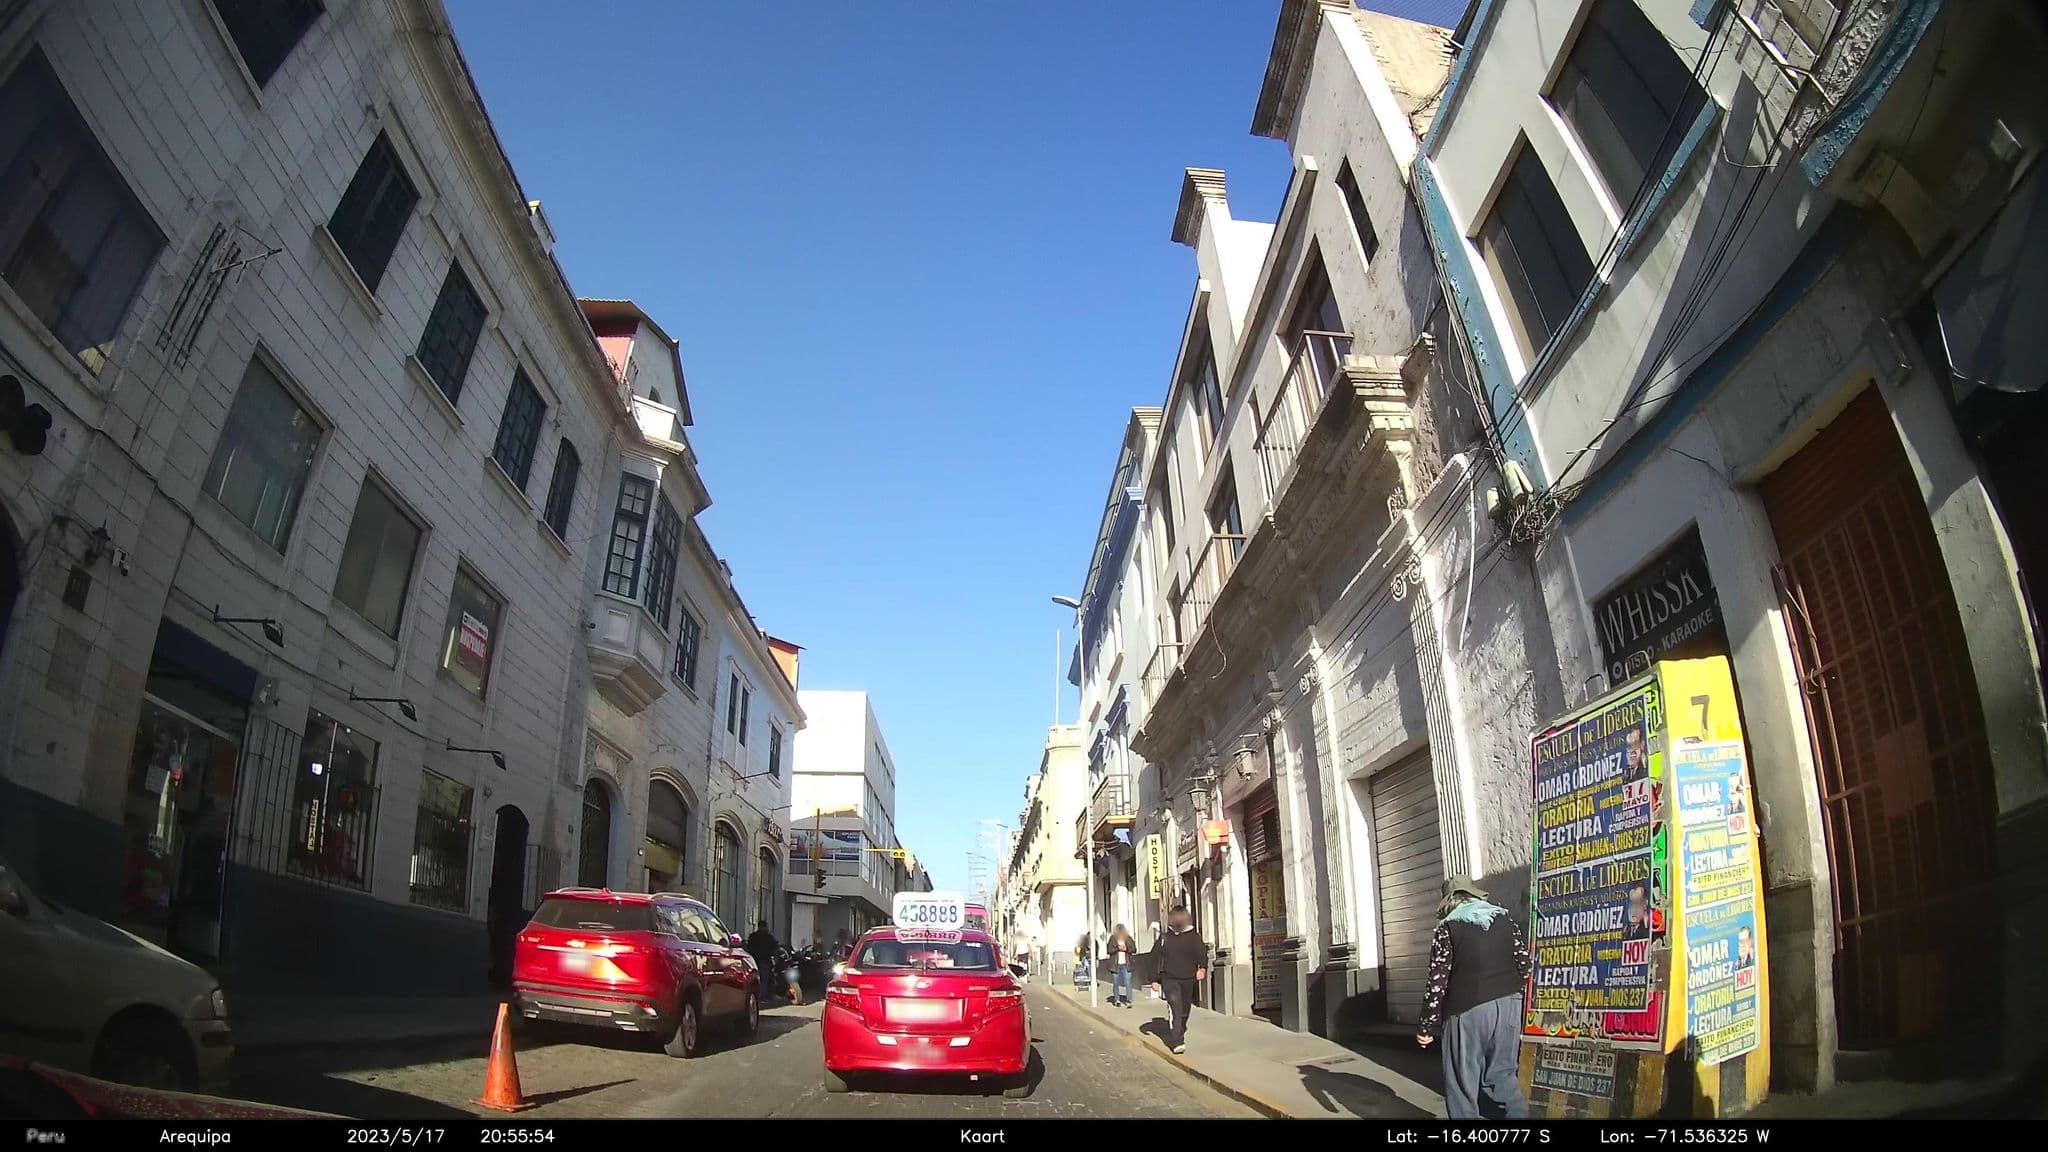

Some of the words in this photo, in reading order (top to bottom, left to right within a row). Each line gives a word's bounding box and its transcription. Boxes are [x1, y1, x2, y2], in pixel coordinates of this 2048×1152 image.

[1661, 608, 1714, 651] KARAOKE
[1690, 694, 1710, 730] 7
[1538, 772, 1571, 802] OMAR
[1542, 796, 1594, 829] ORATORIA
[1623, 795, 1648, 809] MAYO
[1542, 816, 1602, 848] LECTURA
[1729, 815, 1745, 832] HOY
[1543, 844, 1574, 860] EXITO
[1614, 832, 1633, 852] DIOS
[1634, 826, 1649, 847] 237
[1151, 839, 1160, 893] HOSTAL
[1536, 914, 1570, 938] OMAR
[1572, 904, 1624, 935] ORDÓÑEZ
[1539, 943, 1592, 966] ORATORIA
[1624, 941, 1648, 964] HOY
[1692, 939, 1729, 967] OMAR
[1537, 965, 1598, 986] LECTURA
[1736, 969, 1754, 987] HOY
[1536, 988, 1569, 1000] EXITO
[1586, 988, 1605, 1006] JUAN
[1610, 988, 1630, 1006] DIOS
[1630, 987, 1646, 1006] 237
[1695, 985, 1735, 1015] ORATORIA
[1694, 1006, 1733, 1036] LECTURA
[1716, 1018, 1754, 1039] FINANCIERO
[1544, 1049, 1565, 1062] EXITO
[1535, 1069, 1548, 1084] SAN
[1548, 1072, 1567, 1087] JUAN
[1568, 1074, 1578, 1089] DE
[1578, 1076, 1596, 1092] DIOS
[1597, 1078, 1611, 1093] 237
